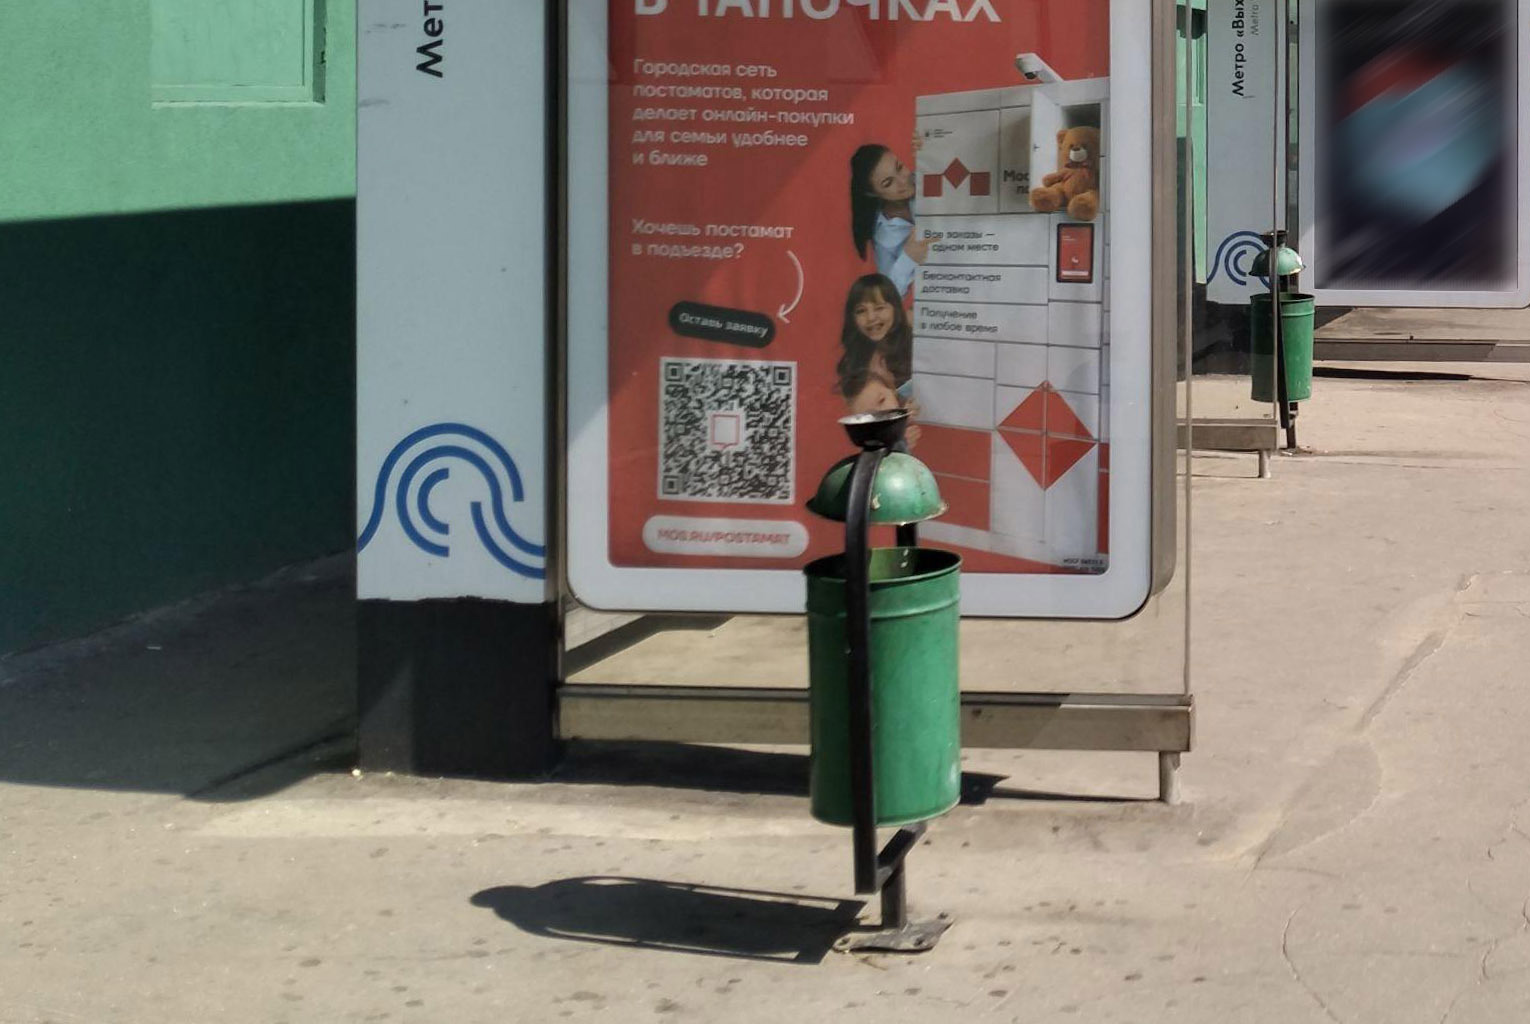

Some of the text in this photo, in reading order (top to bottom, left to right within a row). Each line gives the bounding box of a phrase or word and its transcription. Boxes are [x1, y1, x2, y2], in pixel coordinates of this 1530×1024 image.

[1250, 4, 1259, 37] Metro
[633, 59, 779, 78] Городская сеть
[1231, 43, 1247, 97] Метро
[633, 85, 829, 104] постаматов, которая
[632, 107, 855, 128] делает онлайн-покупки
[632, 129, 809, 149] для семьи удобнее
[633, 150, 709, 167] и ближе
[632, 218, 795, 240] Хочешь постамат
[632, 242, 746, 259] в подъезде?
[967, 244, 1000, 252] месте
[678, 311, 769, 338] Оставь заявку
